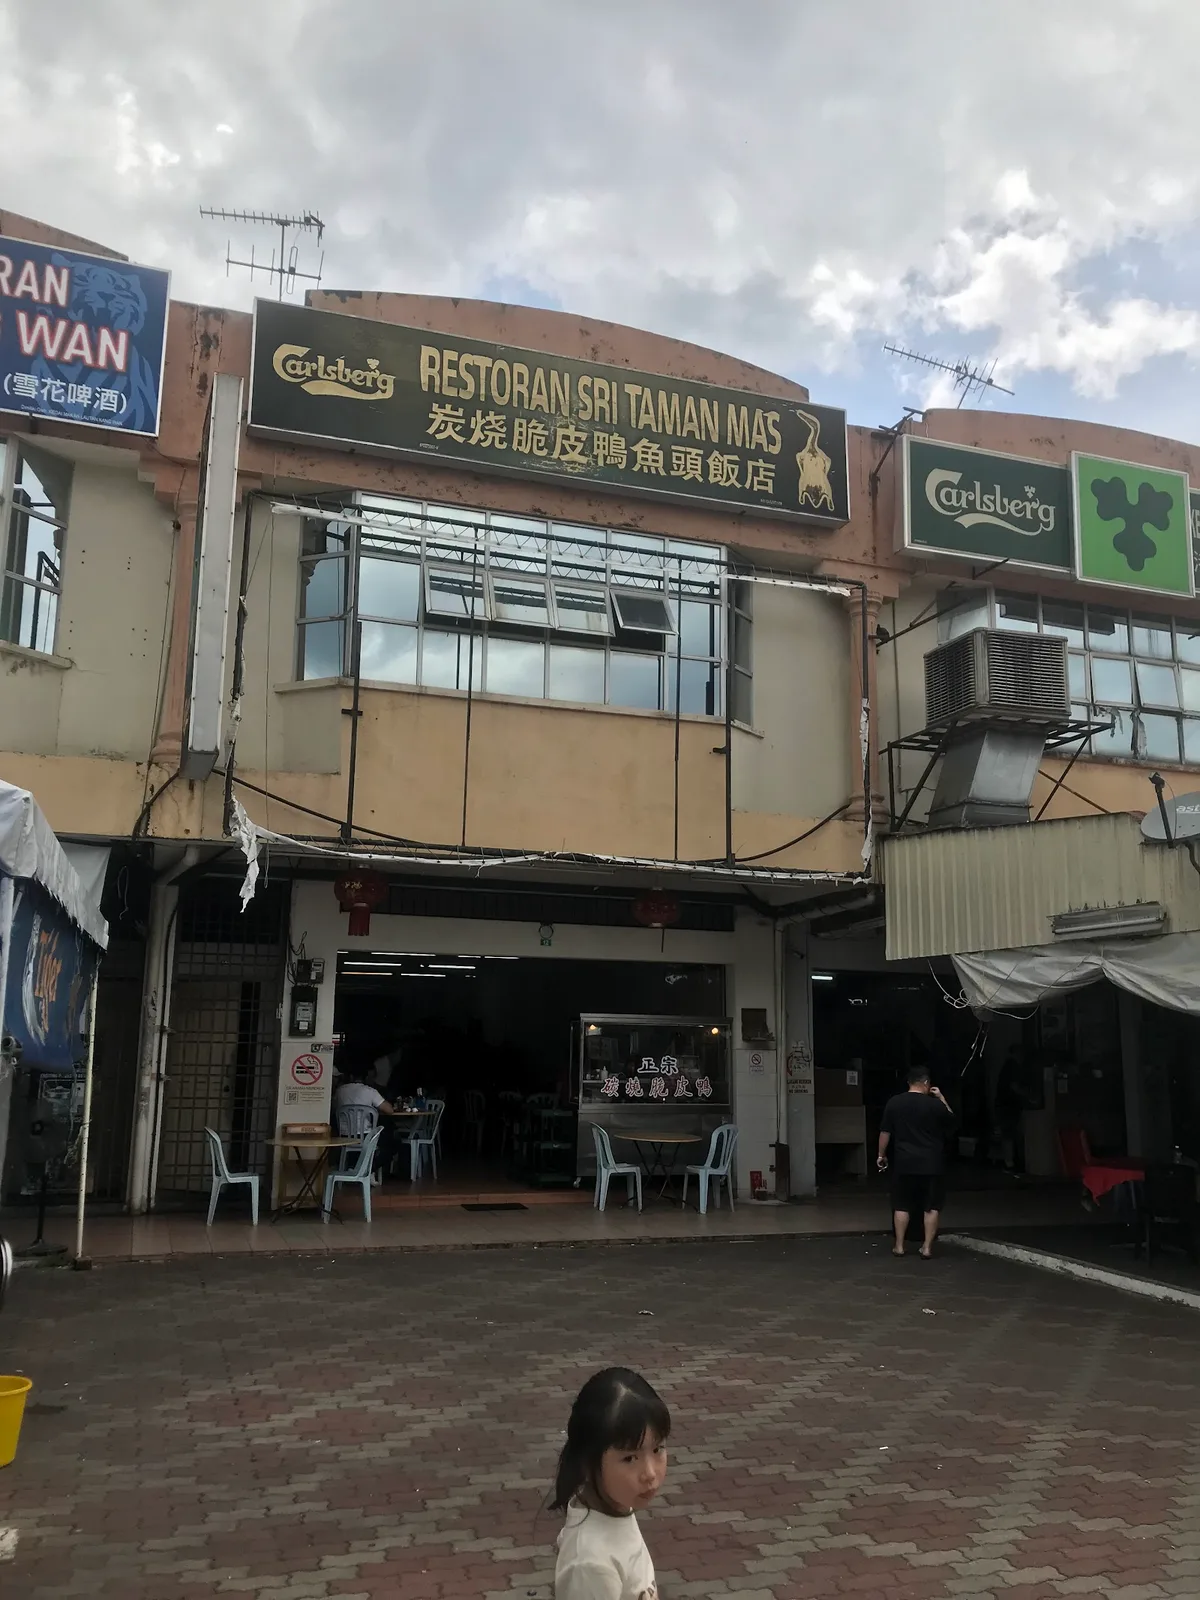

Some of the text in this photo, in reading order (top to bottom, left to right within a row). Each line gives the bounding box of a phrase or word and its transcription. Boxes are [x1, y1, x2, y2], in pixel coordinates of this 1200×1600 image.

[17, 311, 127, 371] WAN
[3, 372, 127, 414] (雪花啤酒)
[272, 343, 395, 400] Carlsberg
[420, 344, 782, 455] RESTORAN SRI TAMAN MAS
[925, 468, 1055, 535] Carlsberg
[637, 1055, 679, 1075] 正宗
